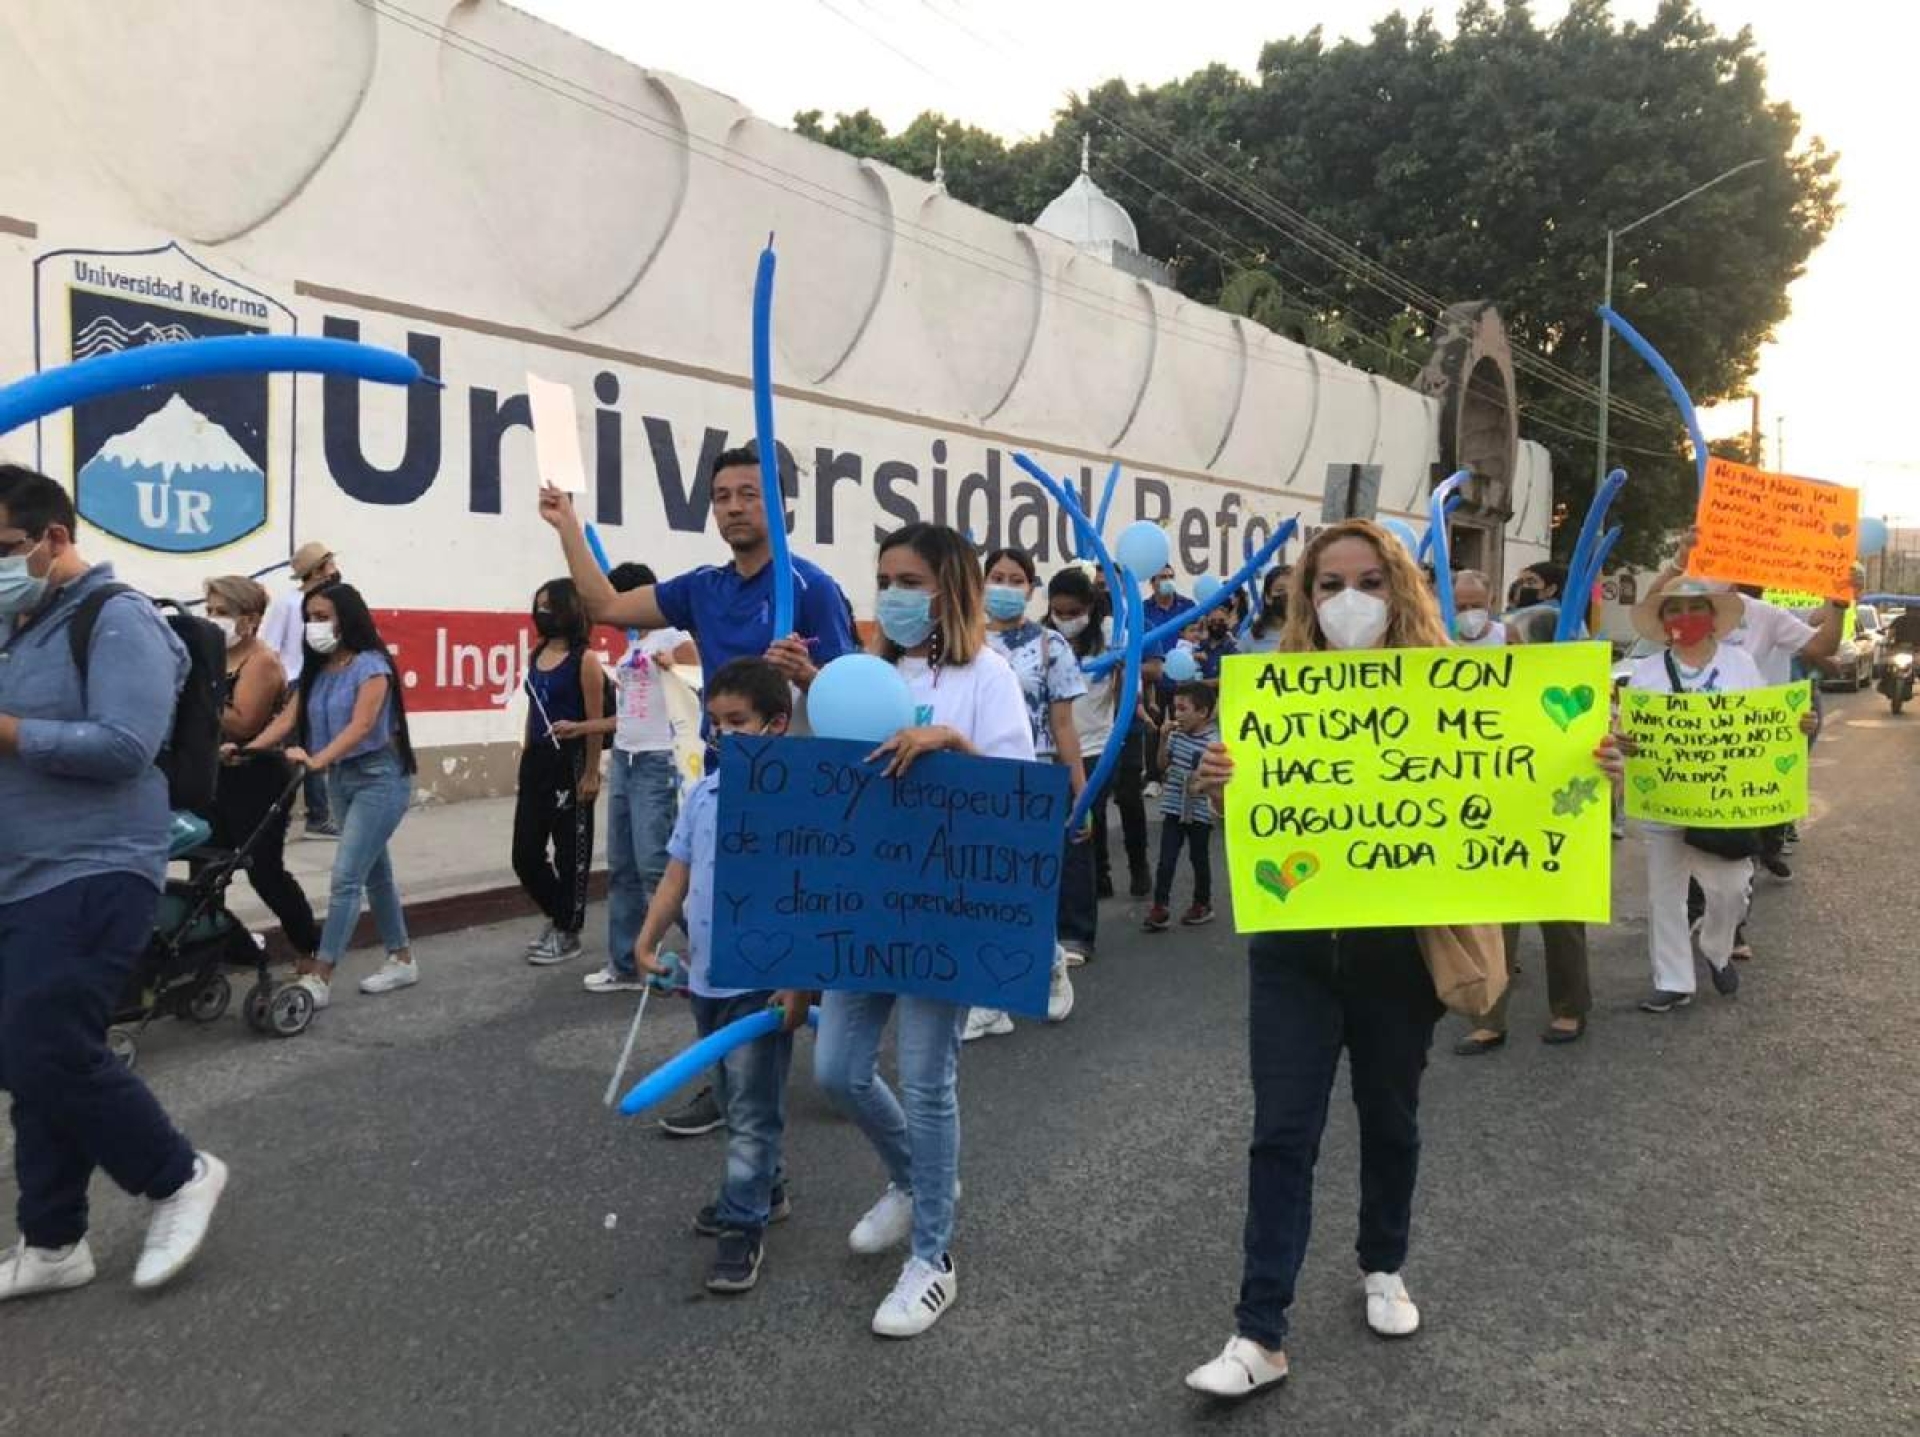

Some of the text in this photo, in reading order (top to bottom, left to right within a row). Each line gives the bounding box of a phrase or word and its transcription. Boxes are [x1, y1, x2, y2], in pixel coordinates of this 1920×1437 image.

[74, 259, 268, 319] Universidad Reforma
[131, 481, 213, 534] UR
[1256, 653, 1513, 697] ALGUIEN CON
[1437, 708, 1505, 742] ME
[732, 741, 789, 795] Yo
[813, 761, 878, 821] soy
[1262, 757, 1355, 789] HACE
[721, 811, 758, 855] de
[775, 823, 857, 858] niños
[920, 823, 1060, 890] AUTISMO
[1346, 839, 1436, 871] CADA
[775, 869, 864, 917] diario
[882, 884, 1033, 928] aprendemos
[816, 929, 958, 985] JUNTOS
